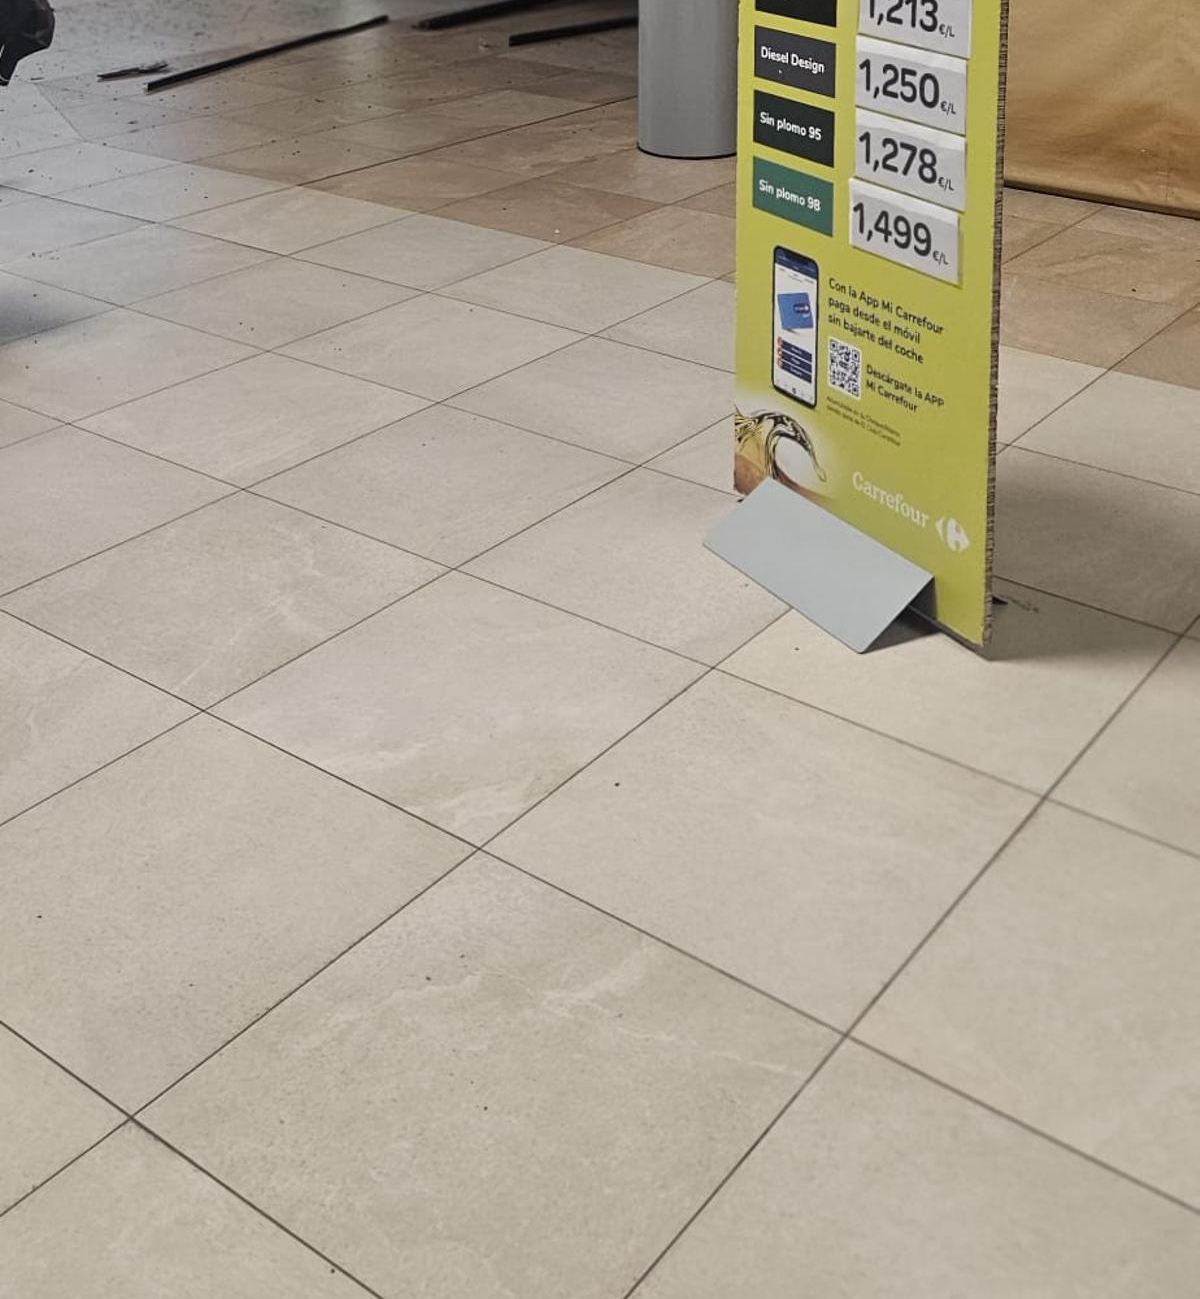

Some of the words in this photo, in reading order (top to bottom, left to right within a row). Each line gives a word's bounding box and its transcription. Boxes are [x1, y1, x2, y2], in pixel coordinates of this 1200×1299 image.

[761, 46, 789, 63] Diesel
[791, 53, 825, 74] Design
[859, 58, 941, 109] 1,250
[760, 111, 775, 126] Sin
[776, 118, 806, 136] plomo
[808, 126, 822, 141] 95
[859, 131, 938, 185] 1,278
[759, 179, 774, 194] Sin
[776, 187, 805, 206] plomo
[807, 196, 821, 211] 98
[852, 202, 932, 257] 1,499
[828, 297, 851, 314] paga
[853, 307, 881, 326] desde
[883, 320, 892, 331] el
[894, 325, 921, 344] móvil
[829, 278, 846, 294] Con
[849, 286, 857, 298] la
[859, 291, 879, 308] App
[882, 300, 893, 314] Mi
[896, 306, 944, 334] Carrefour
[828, 313, 841, 326] sin
[843, 318, 876, 343] bajarte
[878, 336, 893, 350] del
[895, 344, 924, 364] coche
[866, 364, 912, 394] Descárgate
[915, 387, 923, 399] la
[924, 392, 945, 408] APP
[866, 380, 876, 392] Mi
[878, 386, 918, 412] Carrefour
[852, 471, 929, 529] Carrefour
